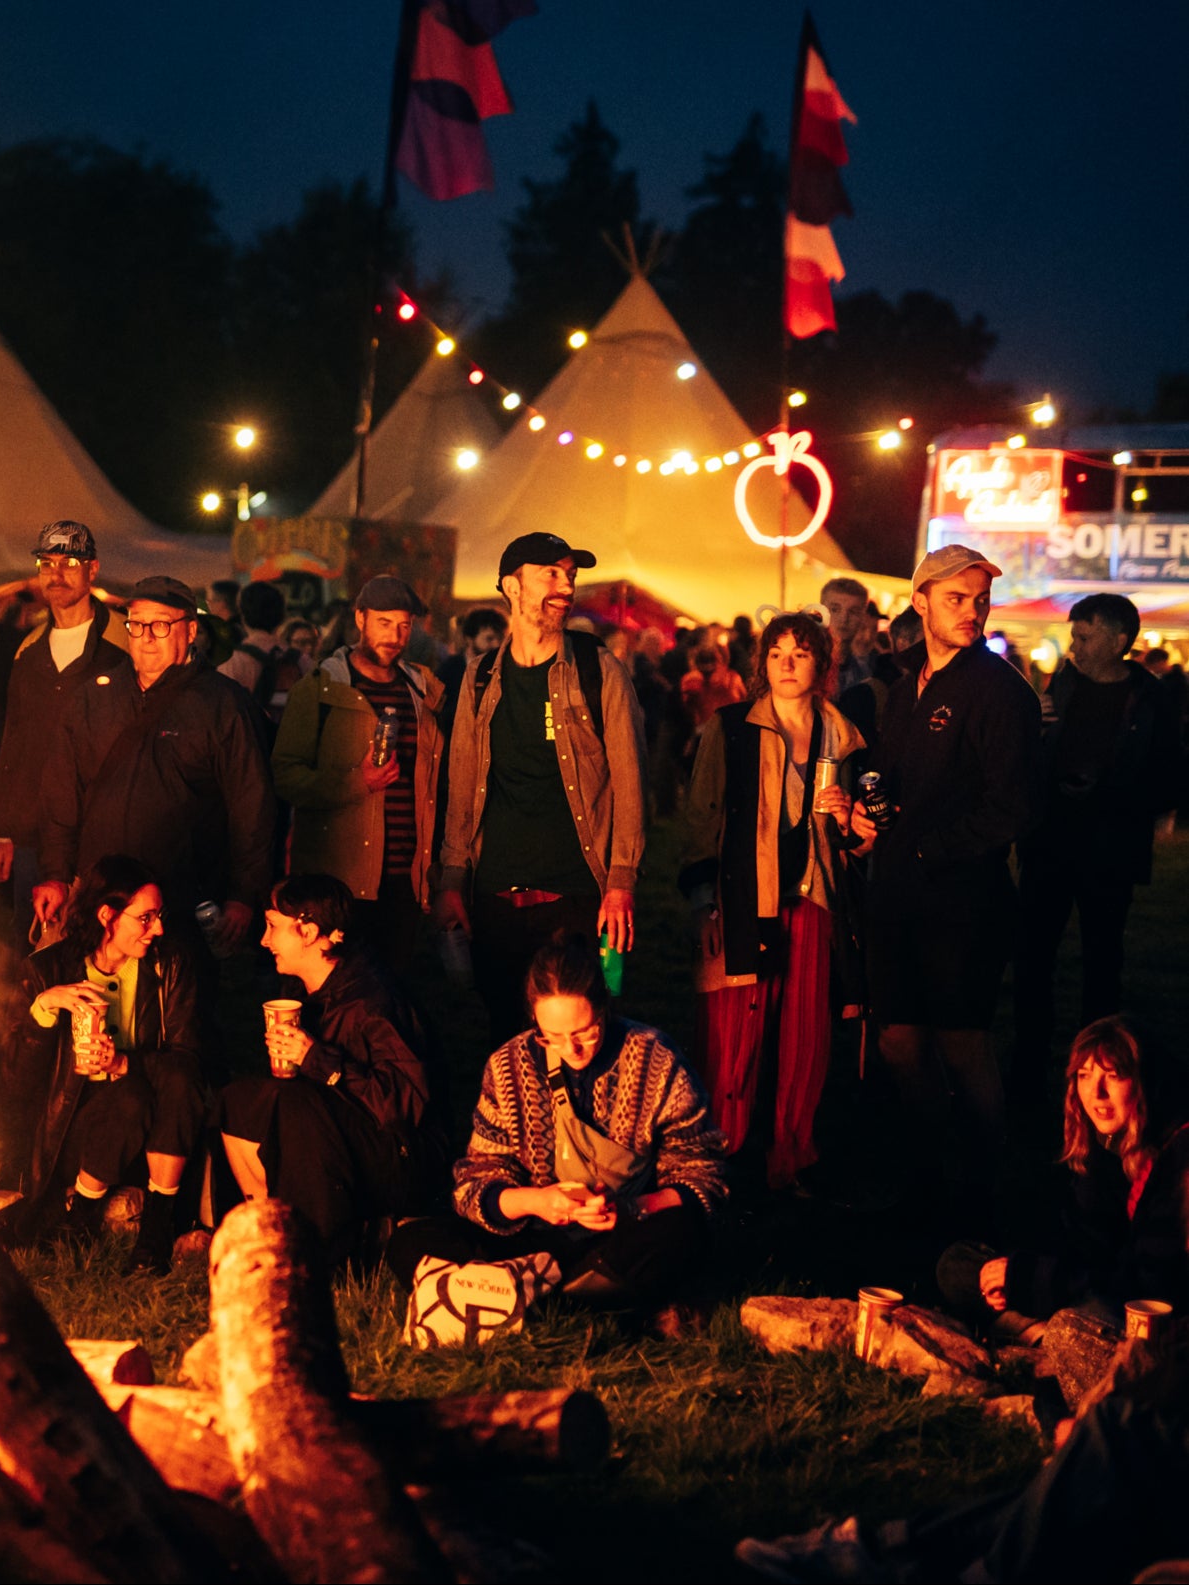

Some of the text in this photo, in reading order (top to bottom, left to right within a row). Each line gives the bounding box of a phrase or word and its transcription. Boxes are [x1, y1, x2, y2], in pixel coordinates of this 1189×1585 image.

[1046, 523, 1189, 559] SOMER
[456, 1278, 474, 1288] NEW
[478, 1284, 510, 1295] YORKER
